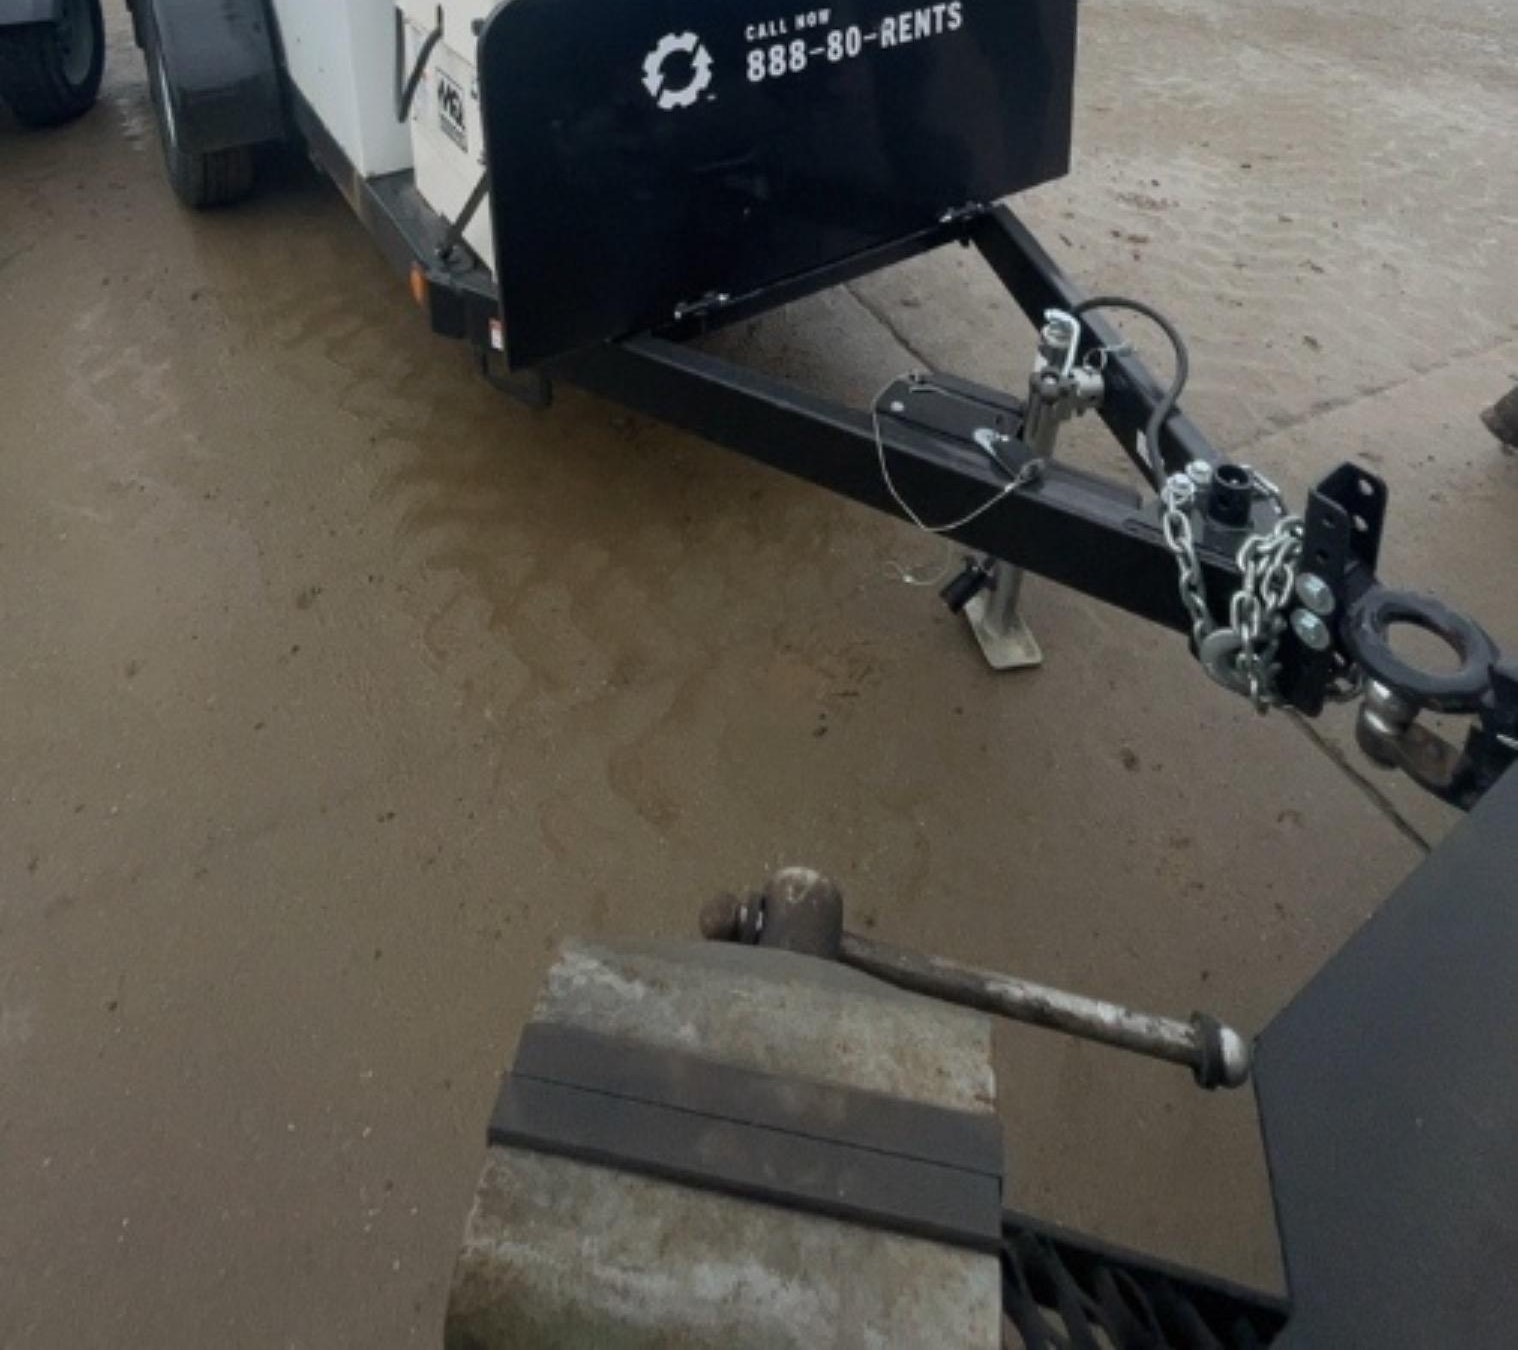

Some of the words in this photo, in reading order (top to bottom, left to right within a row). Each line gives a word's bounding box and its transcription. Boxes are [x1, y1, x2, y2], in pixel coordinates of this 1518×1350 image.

[745, 15, 788, 42] CALL
[795, 7, 831, 30] NOW
[745, 0, 964, 83] 888-80-RENTS
